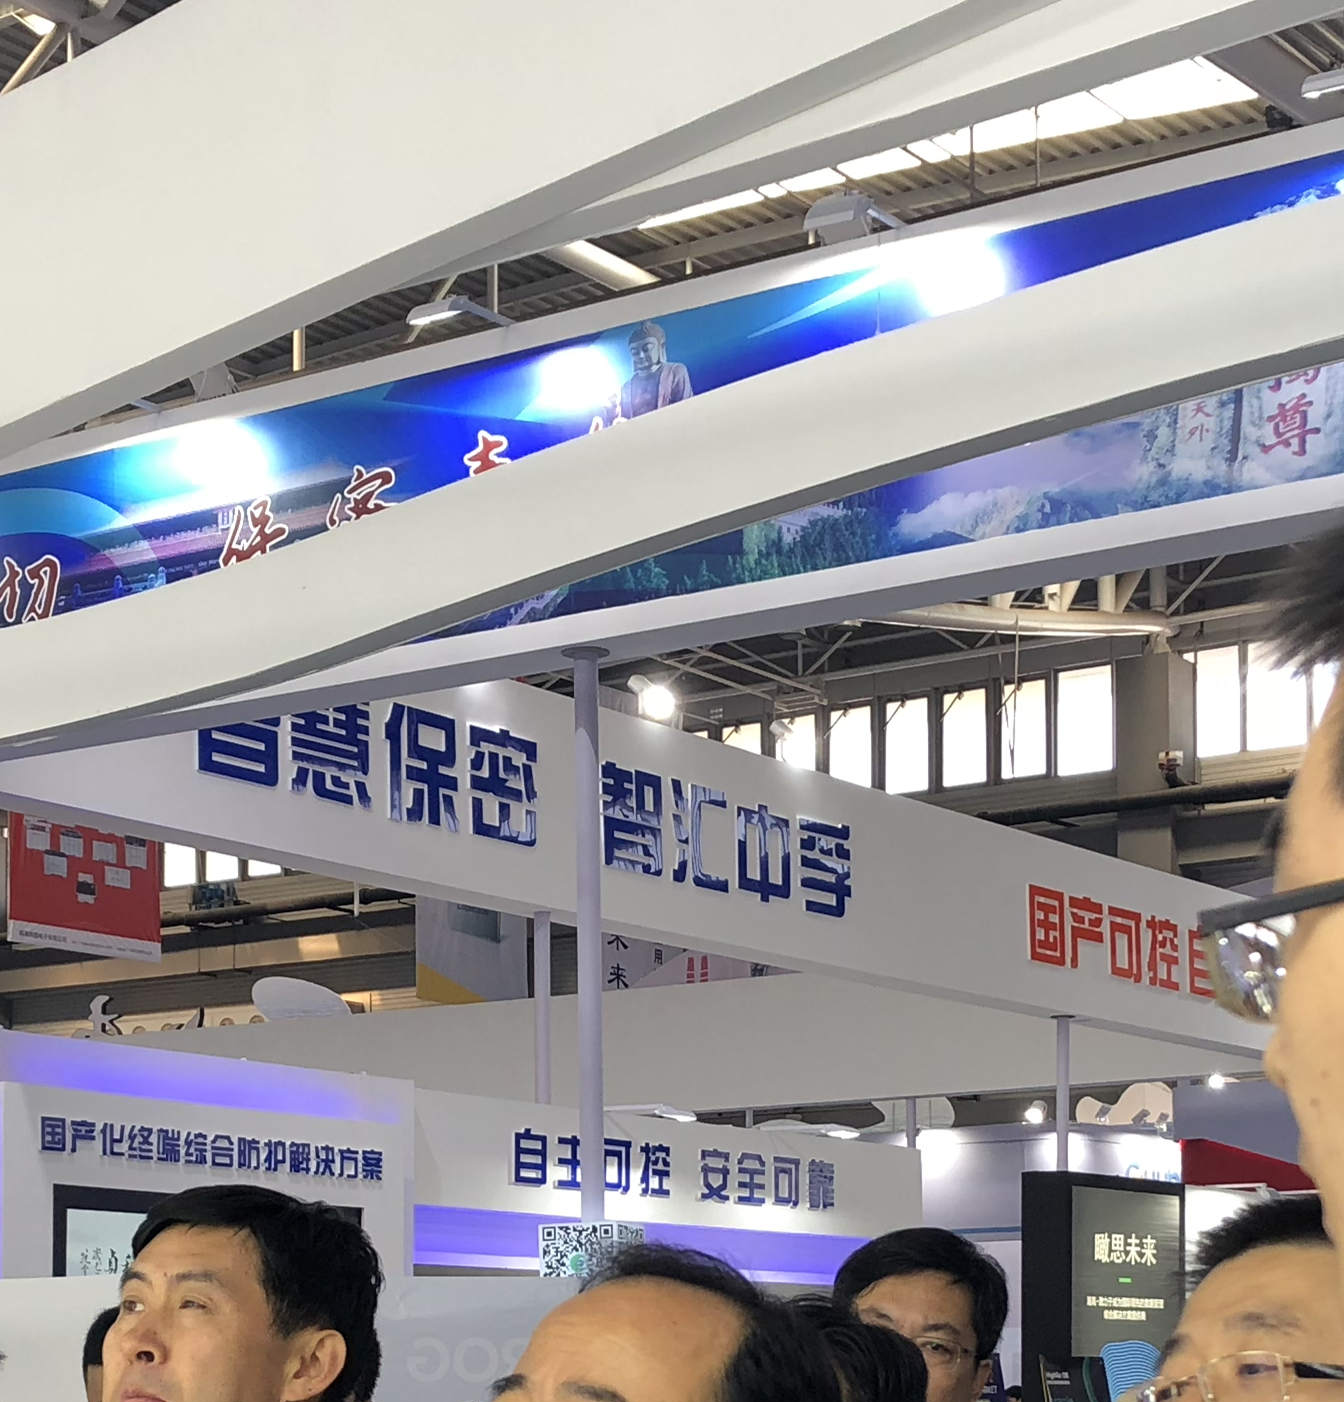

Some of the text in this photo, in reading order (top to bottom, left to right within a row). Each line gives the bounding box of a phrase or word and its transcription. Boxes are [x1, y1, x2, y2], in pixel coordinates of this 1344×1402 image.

[40, 1116, 385, 1182] 国产化终端综合防护解决方案
[514, 1128, 834, 1209] 自主可控 安全可靠
[1093, 1231, 1158, 1267] 瞰思未来
